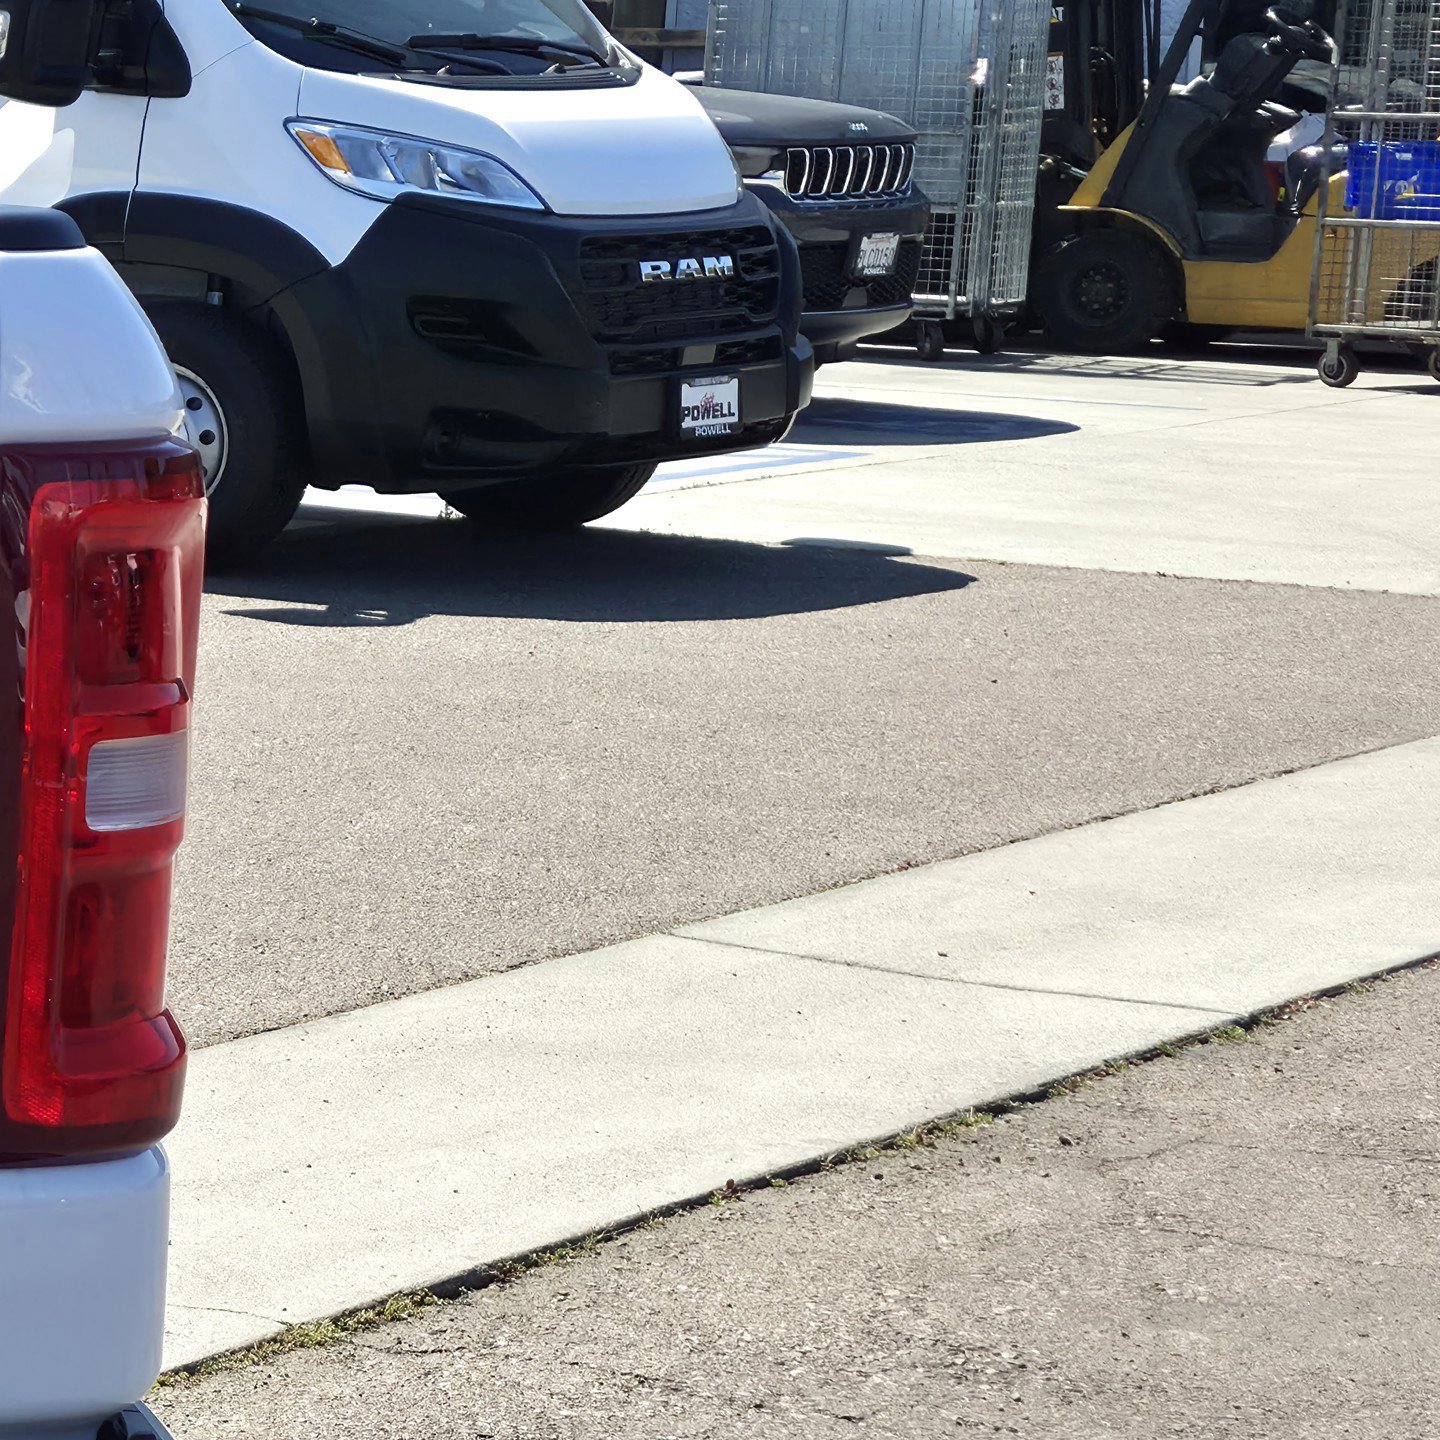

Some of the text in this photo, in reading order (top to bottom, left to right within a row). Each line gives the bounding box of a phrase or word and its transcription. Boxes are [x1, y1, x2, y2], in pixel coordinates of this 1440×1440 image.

[639, 254, 734, 282] RAM
[681, 400, 736, 422] POWELL
[695, 423, 731, 436] POWELL
